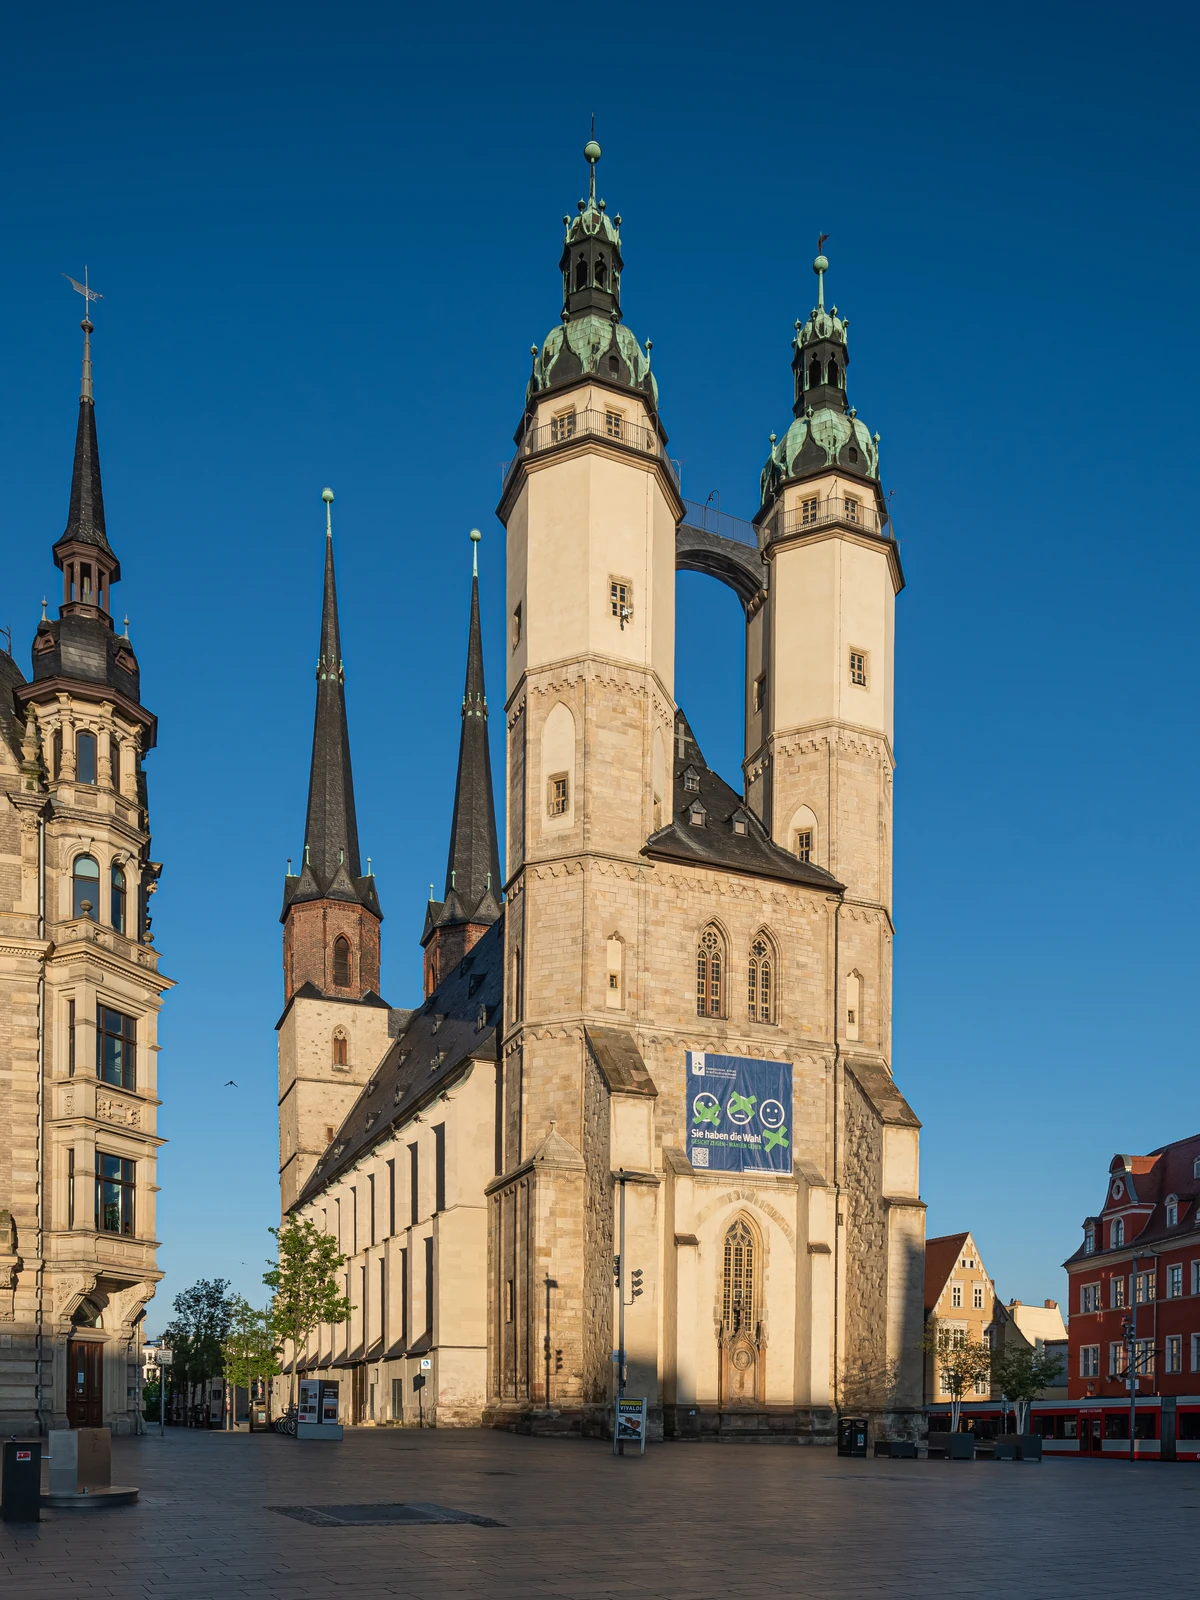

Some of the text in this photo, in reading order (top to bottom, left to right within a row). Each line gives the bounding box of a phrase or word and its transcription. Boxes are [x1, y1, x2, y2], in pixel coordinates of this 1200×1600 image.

[691, 1128, 761, 1143] Sie haben die Wahl
